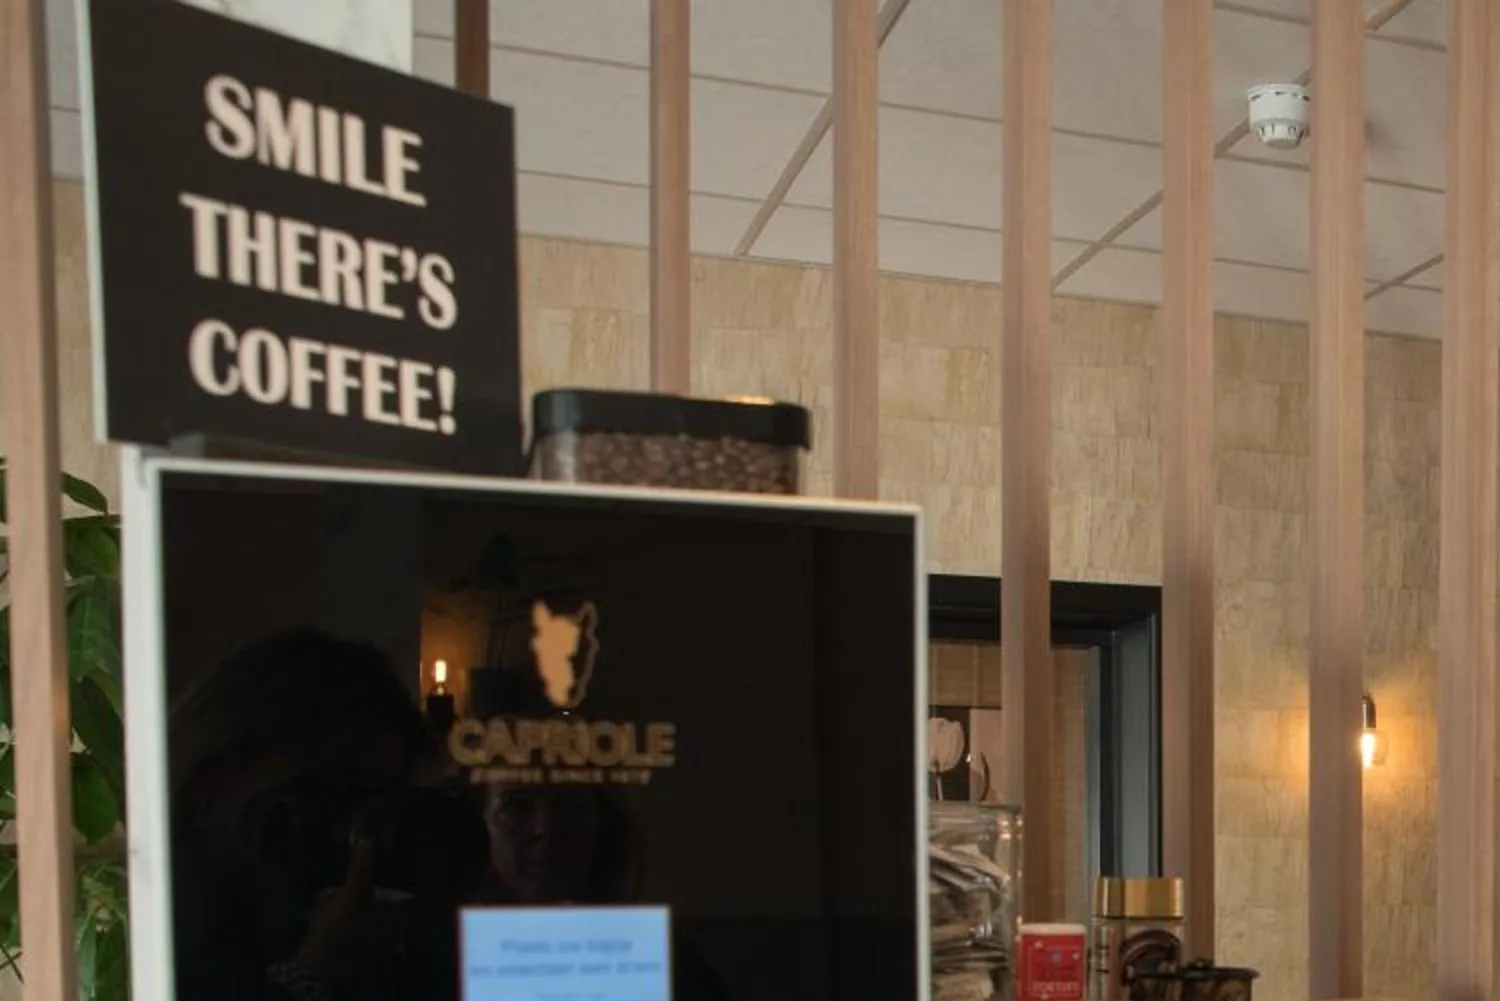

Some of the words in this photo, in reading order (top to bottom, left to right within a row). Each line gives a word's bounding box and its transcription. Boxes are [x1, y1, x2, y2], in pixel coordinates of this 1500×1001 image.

[204, 73, 428, 206] SMILE
[177, 191, 459, 331] THERE'S
[188, 318, 458, 436] COFFEE!
[450, 717, 677, 767] CAPRIOLE
